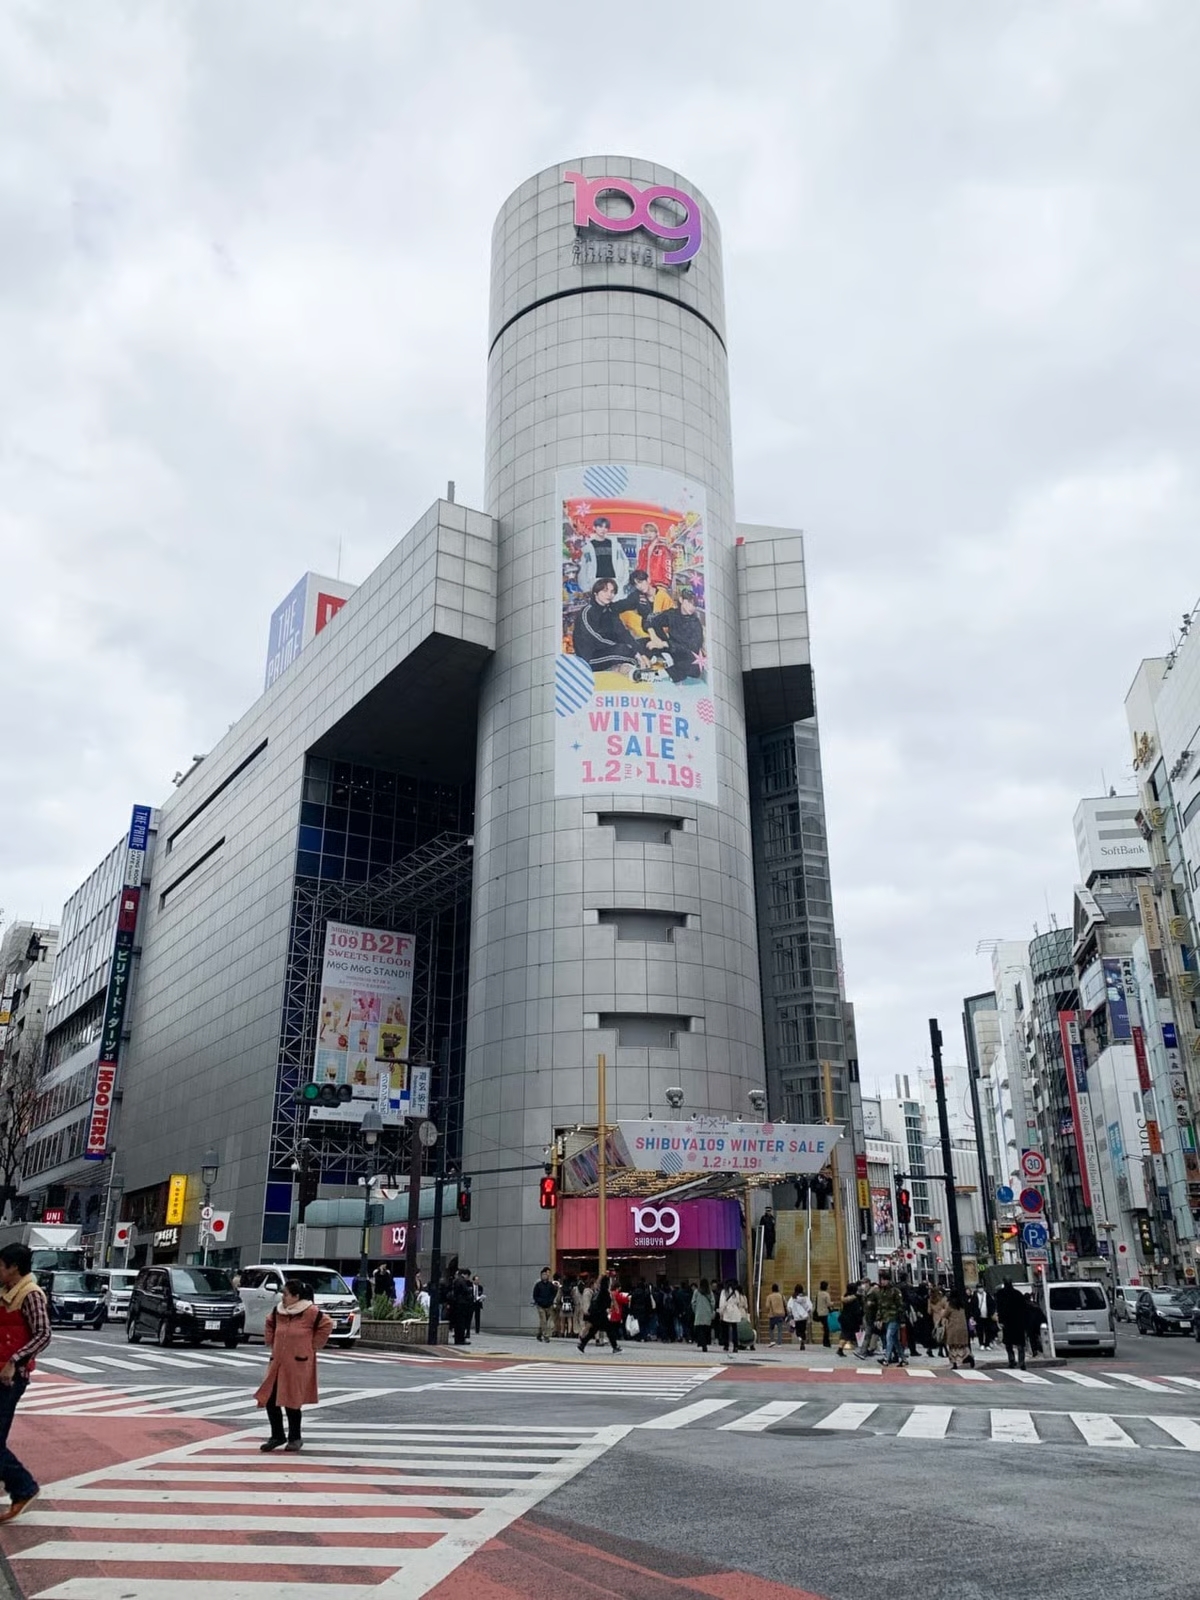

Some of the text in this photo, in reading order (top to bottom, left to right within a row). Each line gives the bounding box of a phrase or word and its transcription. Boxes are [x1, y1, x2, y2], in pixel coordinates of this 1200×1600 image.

[564, 171, 703, 264] 109
[278, 599, 297, 650] THE
[596, 696, 681, 712] SHIBUYA109
[588, 711, 689, 738] WINTER
[607, 735, 675, 759] SALE
[582, 760, 621, 782] 1.2
[646, 762, 694, 788] 1.19
[131, 812, 148, 848] THE PRIME
[1101, 845, 1145, 856] SoftBank
[330, 932, 412, 955] 109 B2F
[328, 949, 411, 967] SWEETS FLOOR
[105, 951, 128, 1050] ビリヤード・ダーツ
[418, 1072, 427, 1113] 道玄坂下
[90, 1070, 114, 1146] HOOTERS
[636, 1137, 825, 1153] SHIBUYA109 WINTER SALE
[703, 1156, 721, 1167] 1.2
[732, 1156, 758, 1168] 1.19
[1027, 1159, 1040, 1170] 30
[204, 1208, 210, 1217] 4
[631, 1206, 680, 1246] 109
[1029, 1230, 1038, 1245] P
[392, 1227, 406, 1250] 109
[634, 1237, 664, 1246] SHIBUYA
